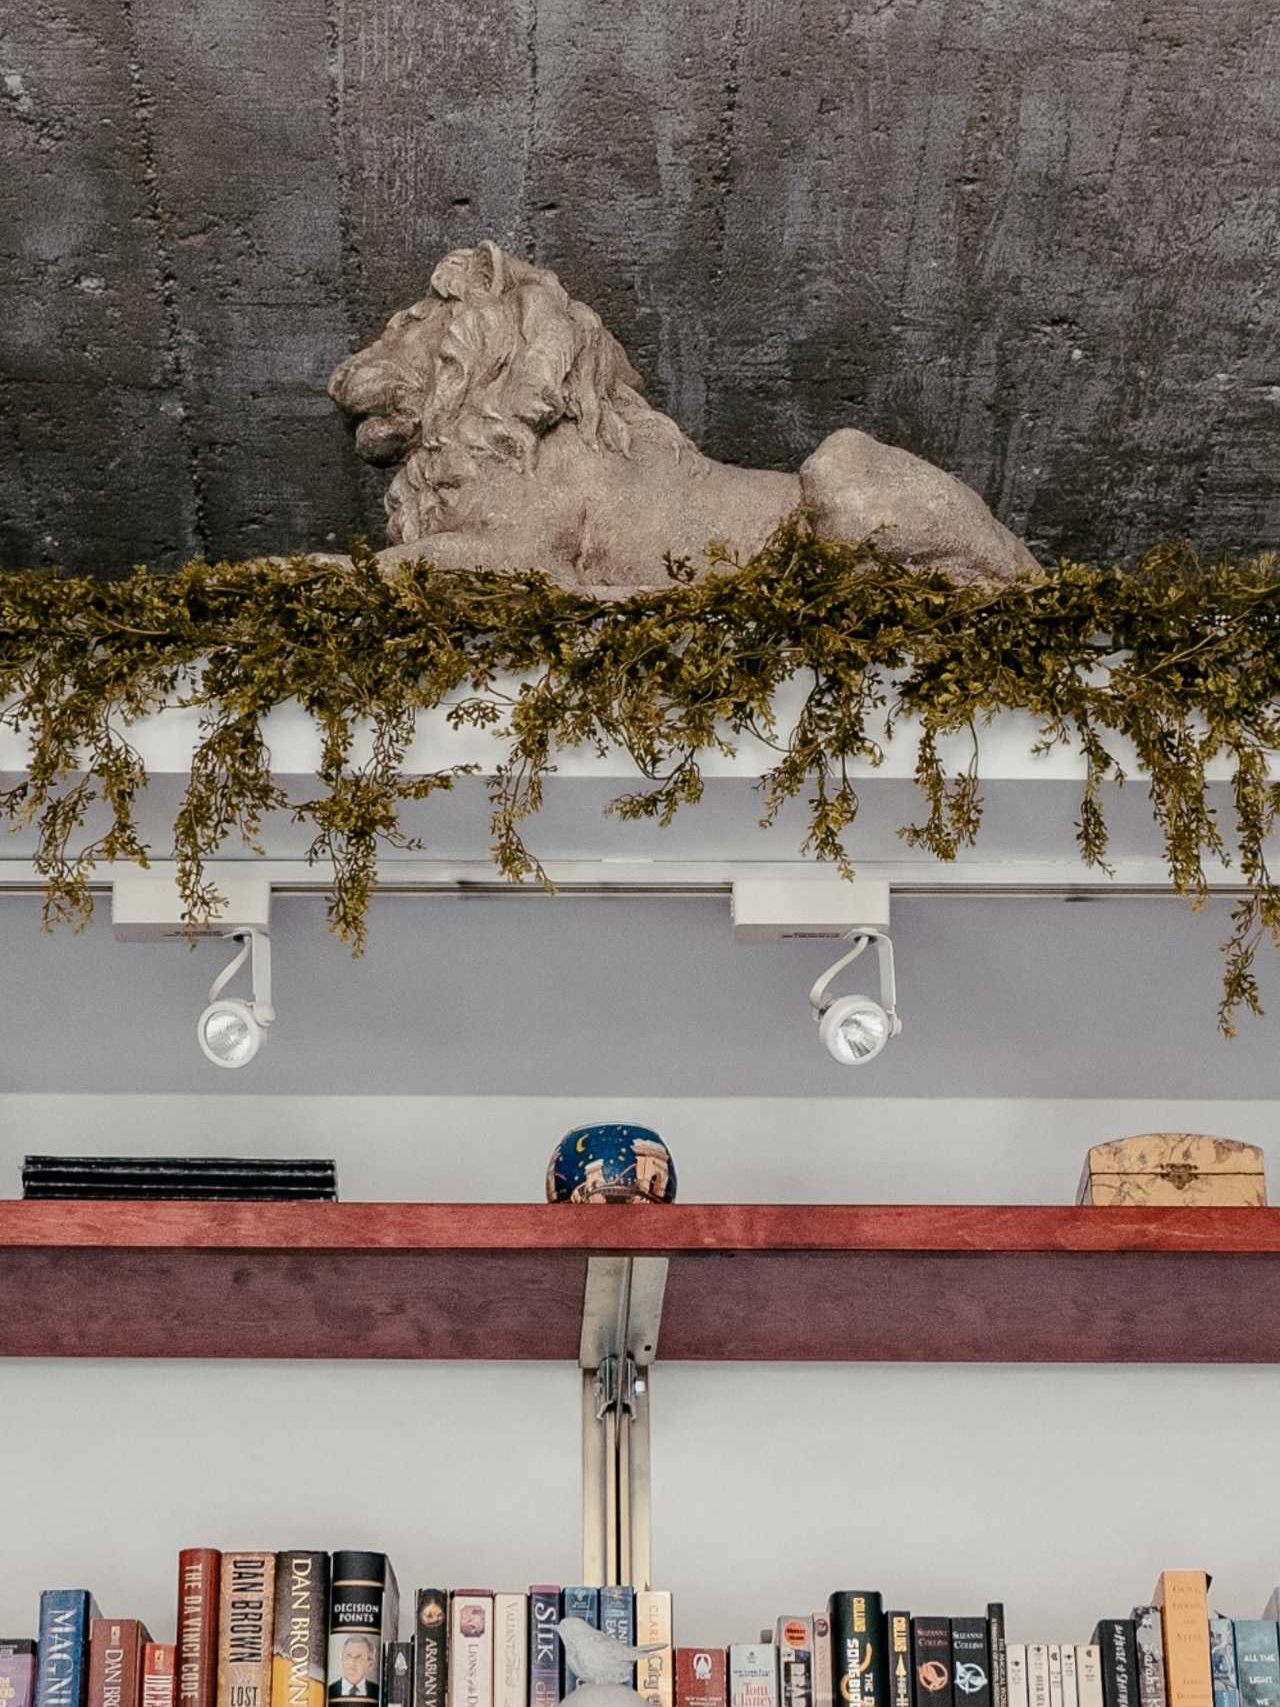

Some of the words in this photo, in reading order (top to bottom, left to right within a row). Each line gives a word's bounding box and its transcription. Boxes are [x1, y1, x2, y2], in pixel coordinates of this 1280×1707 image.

[184, 1563, 202, 1590] THE
[231, 1559, 266, 1593] DAN
[290, 1557, 313, 1610] DAN
[183, 1595, 202, 1614] DA
[334, 1602, 379, 1613] DECISION
[339, 1613, 375, 1622] POINTS
[852, 1597, 866, 1633] COLLINS
[182, 1616, 202, 1658] VINCI
[228, 1600, 264, 1664] BROWN
[104, 1648, 123, 1683] DAN
[289, 1616, 311, 1706] BROWN
[424, 1637, 438, 1695] ARABIAN
[180, 1663, 199, 1699] CODE
[229, 1686, 259, 1707] LOST
[863, 1673, 875, 1693] THE
